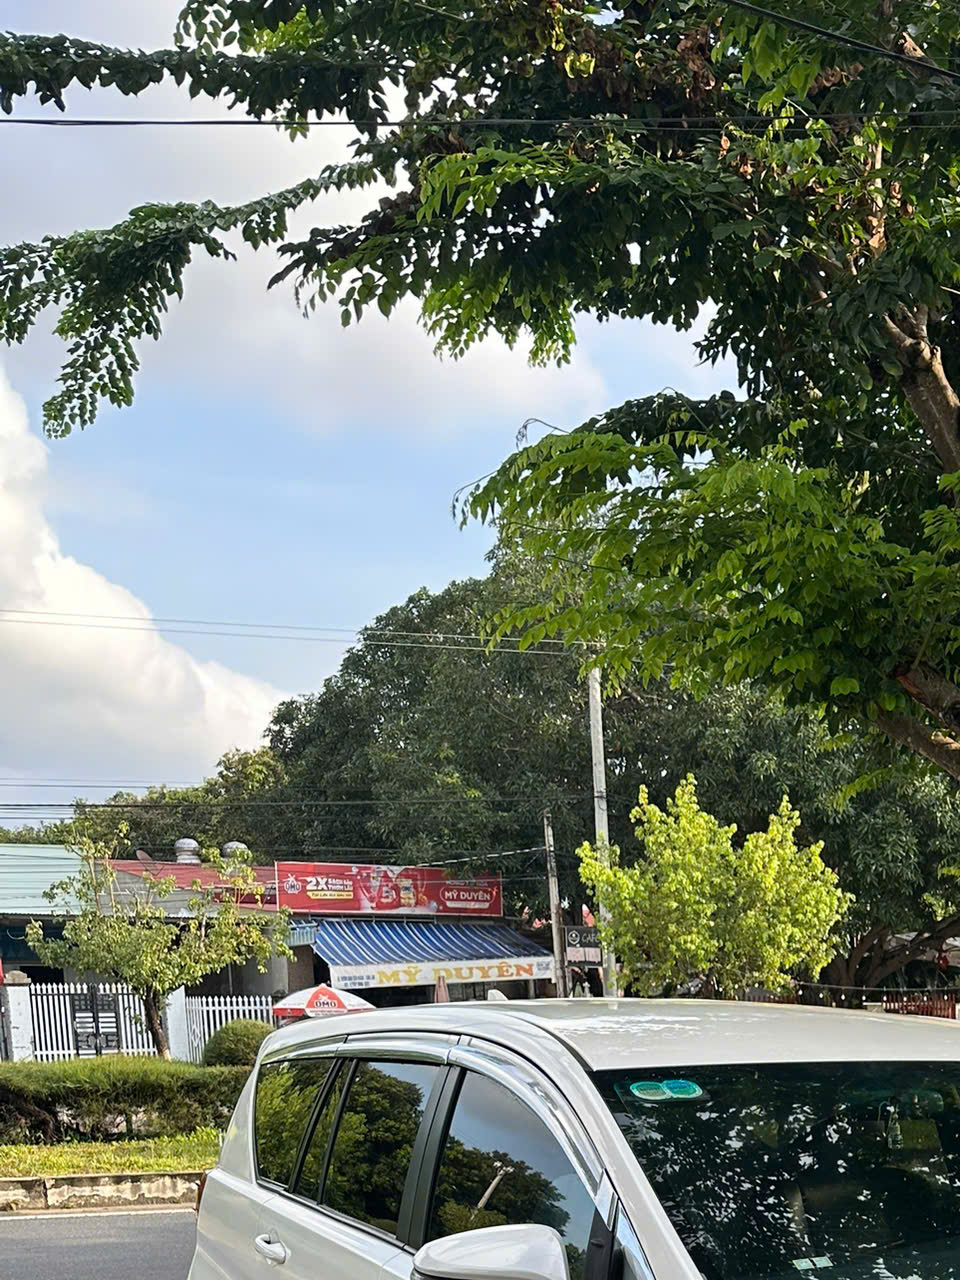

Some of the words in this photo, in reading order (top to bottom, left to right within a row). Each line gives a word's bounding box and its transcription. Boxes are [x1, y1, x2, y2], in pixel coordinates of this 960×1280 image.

[306, 877, 328, 890] 2X
[376, 964, 422, 985] MỸ
[432, 961, 534, 981] DUYÊN
[315, 1000, 337, 1008] OMO
